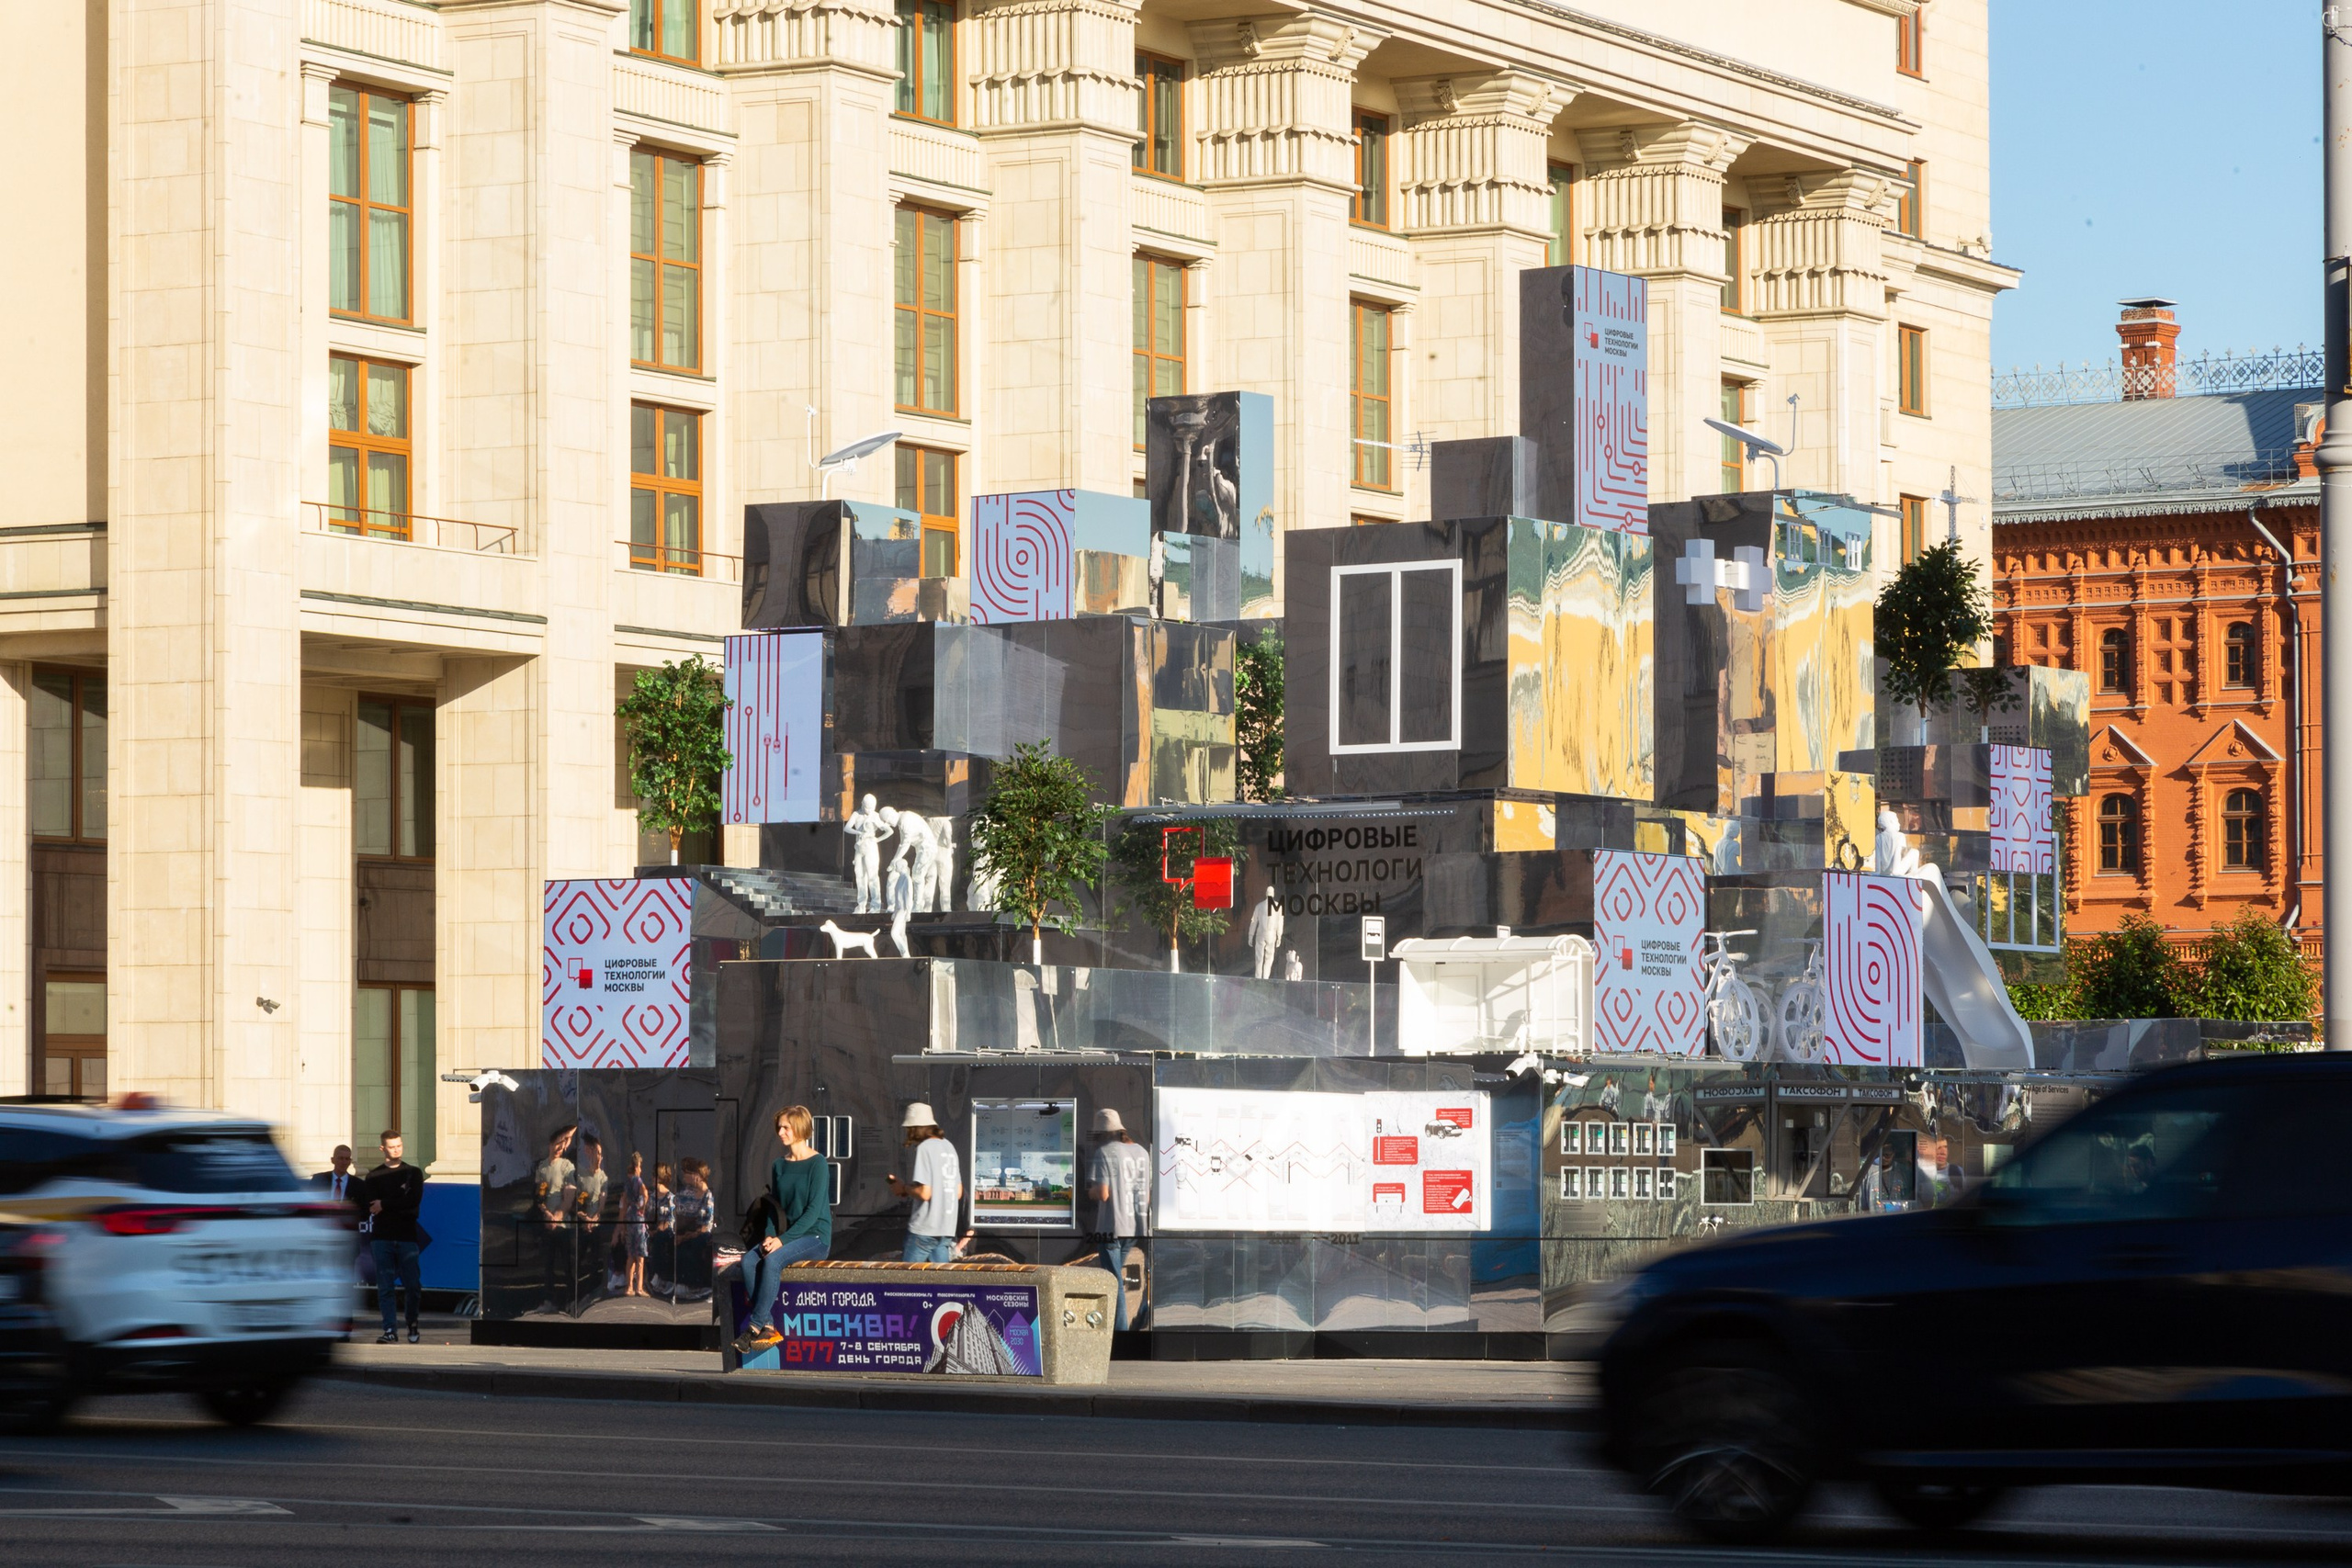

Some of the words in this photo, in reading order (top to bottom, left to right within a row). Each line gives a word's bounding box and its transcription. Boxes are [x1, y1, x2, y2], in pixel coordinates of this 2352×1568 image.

[1605, 328, 1634, 339] ЦИФРОВЫЕ
[1605, 338, 1638, 350] ТЕХНОЛОГИИ
[1605, 347, 1627, 356] МОСКВЫ
[1268, 825, 1418, 855] ЦИФРОВЫЕ
[1267, 857, 1423, 886] ТЕХНОЛОГИ
[1267, 892, 1381, 917] МОСКВЫ
[1641, 940, 1680, 952] ЦИФРОВЫЕ
[605, 958, 657, 969] ЦИФРОВЫЕ
[1641, 953, 1687, 964] ТЕХНОЛОГИИ
[605, 970, 665, 980] ТЕХНОЛОГИИ
[1641, 965, 1671, 976] МОСКВЫ
[605, 983, 644, 992] МОСКВЫ
[1783, 1086, 1841, 1097] ТАКСОФОН
[1859, 1089, 1894, 1099] ТАКСОФОН
[2032, 1086, 2041, 1094] Age
[2048, 1086, 2069, 1094] Services
[1330, 1234, 1360, 1245] 2011
[782, 1291, 788, 1306] С
[796, 1290, 827, 1306] ДНЁМ
[832, 1292, 876, 1307] ГОРОДА,
[922, 1301, 933, 1309] 0+
[783, 1313, 919, 1338] МОСКВА!
[786, 1340, 834, 1363] 877
[840, 1341, 863, 1350] 7-8
[867, 1342, 922, 1352] СЕНТЯБРЯ
[838, 1354, 870, 1364] ДЕНЬ
[876, 1355, 922, 1365] ГОРОДА
